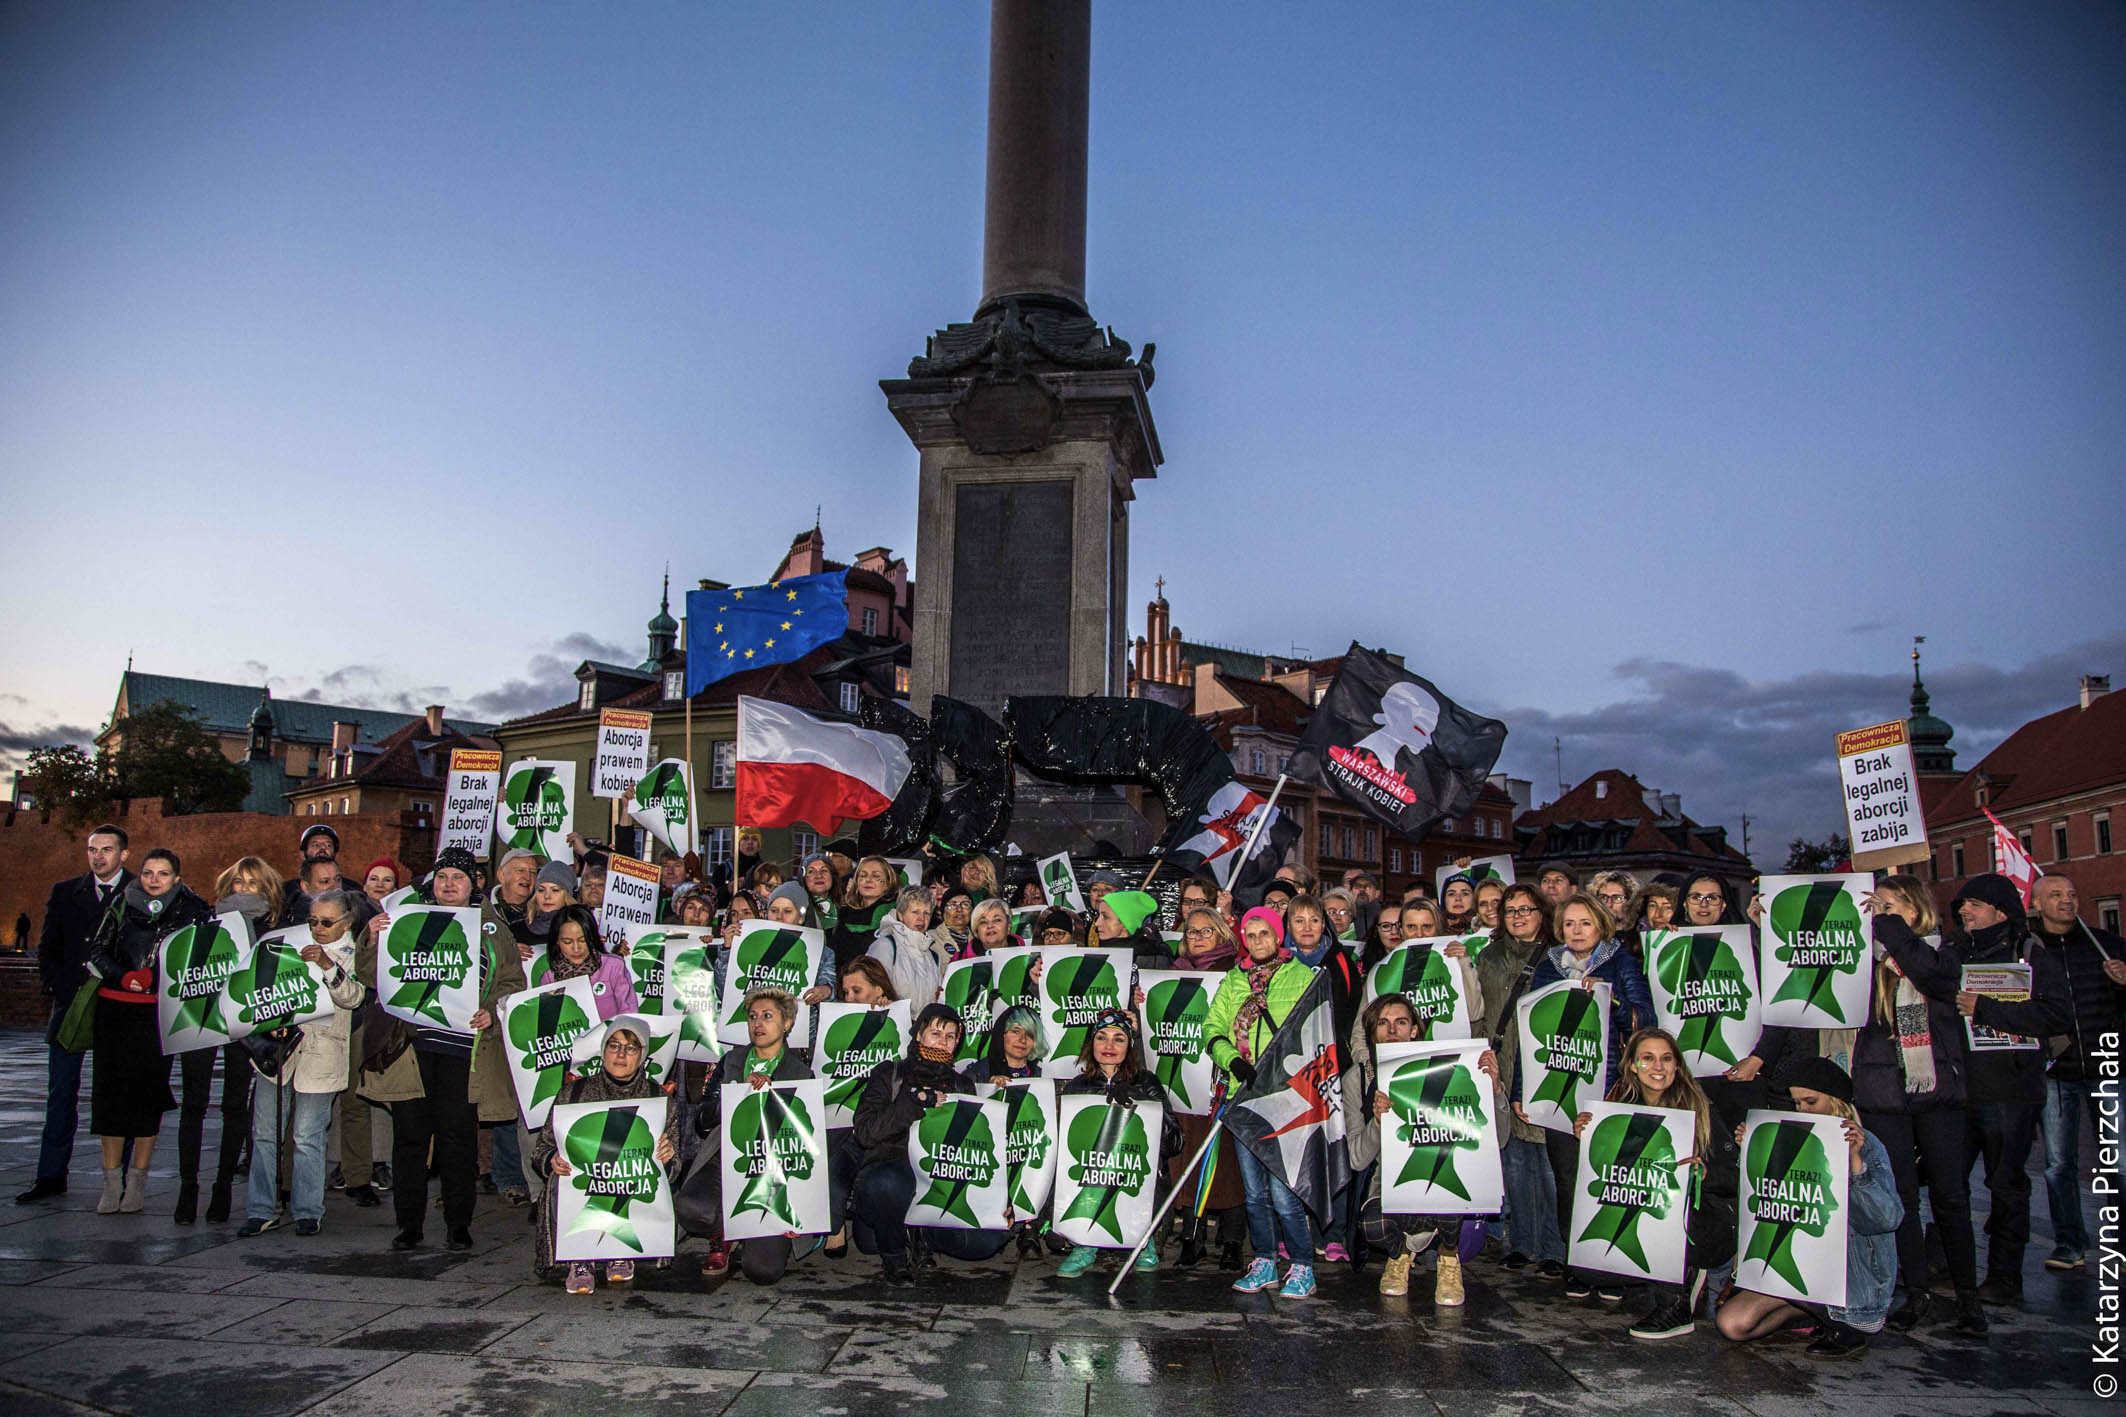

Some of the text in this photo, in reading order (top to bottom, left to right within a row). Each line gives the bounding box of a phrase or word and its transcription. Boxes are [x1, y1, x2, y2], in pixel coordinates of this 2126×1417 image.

[604, 728, 643, 751] Aborcja
[1841, 723, 1900, 743] Pracownicza
[1844, 733, 1900, 753] Demokracja
[456, 751, 500, 761] Pracownicza
[456, 761, 497, 770] Demokracja
[600, 755, 643, 770] prawem
[1854, 753, 1892, 775] Brak
[460, 775, 488, 791] Brak
[1341, 751, 1409, 799] WARSZAWSKI
[1327, 760, 1407, 815] STRAJK KOBIET
[1846, 772, 1909, 801] legalnej
[448, 796, 494, 814] legalnej
[515, 802, 560, 815] LEGALNA
[644, 795, 686, 809] LEGALNA
[1854, 795, 1909, 822] aborcji
[448, 815, 489, 833] aborcji
[1861, 820, 1908, 843] zabija
[449, 834, 483, 851] zabija
[613, 855, 659, 873] Pracownicza
[614, 863, 657, 881] Demokracja
[612, 875, 653, 904] Aborcja
[605, 903, 651, 925] prawem
[1824, 920, 1853, 929] TERAZ!
[1788, 930, 1857, 947] LEGALNA
[401, 950, 463, 966] LEGALNA
[1791, 949, 1854, 965] ABORCJA
[177, 960, 236, 985] LEGALNA
[403, 967, 460, 981] ABORCJA
[746, 963, 800, 984] LEGALNA
[181, 978, 227, 1000] ABORC
[245, 975, 310, 1009] LEGALNA
[1400, 984, 1450, 1005] GALNA
[1676, 979, 1741, 999] LEGALNA
[254, 992, 313, 1023] ABORCJA
[1011, 994, 1040, 1009] LEGA
[1061, 995, 1113, 1010] LEGALNA
[1414, 1001, 1450, 1020] RCJA
[1682, 997, 1742, 1016] ABORCJA
[1155, 1021, 1202, 1039] LEGALNA
[835, 1049, 893, 1063] LEGALNA
[1158, 1039, 1198, 1055] ABORCJA
[1546, 1033, 1597, 1059] LEGALNA
[834, 1064, 872, 1078] ABOR
[1315, 1043, 1343, 1103] STRAJ
[1547, 1052, 1593, 1076] ABORCJA
[1407, 1105, 1477, 1126] LEGALNA
[1006, 1129, 1043, 1147] ALNA
[1411, 1126, 1475, 1144] ABORCJA
[745, 1137, 809, 1157] LEGALNA
[931, 1142, 990, 1166] LEGALNA
[1006, 1146, 1041, 1163] ORCJA
[584, 1158, 654, 1180] LEGALNA
[1081, 1150, 1142, 1171] LEGALNA
[931, 1161, 988, 1181] ABORCJA
[1081, 1169, 1138, 1188] ABORCJA
[1601, 1164, 1669, 1190] LEGALNA
[588, 1178, 652, 1195] ABORCJA
[1601, 1184, 1665, 1209] ABORCJA
[1756, 1177, 1825, 1205] LEGALNA
[1756, 1199, 1822, 1226] ABORCJA
